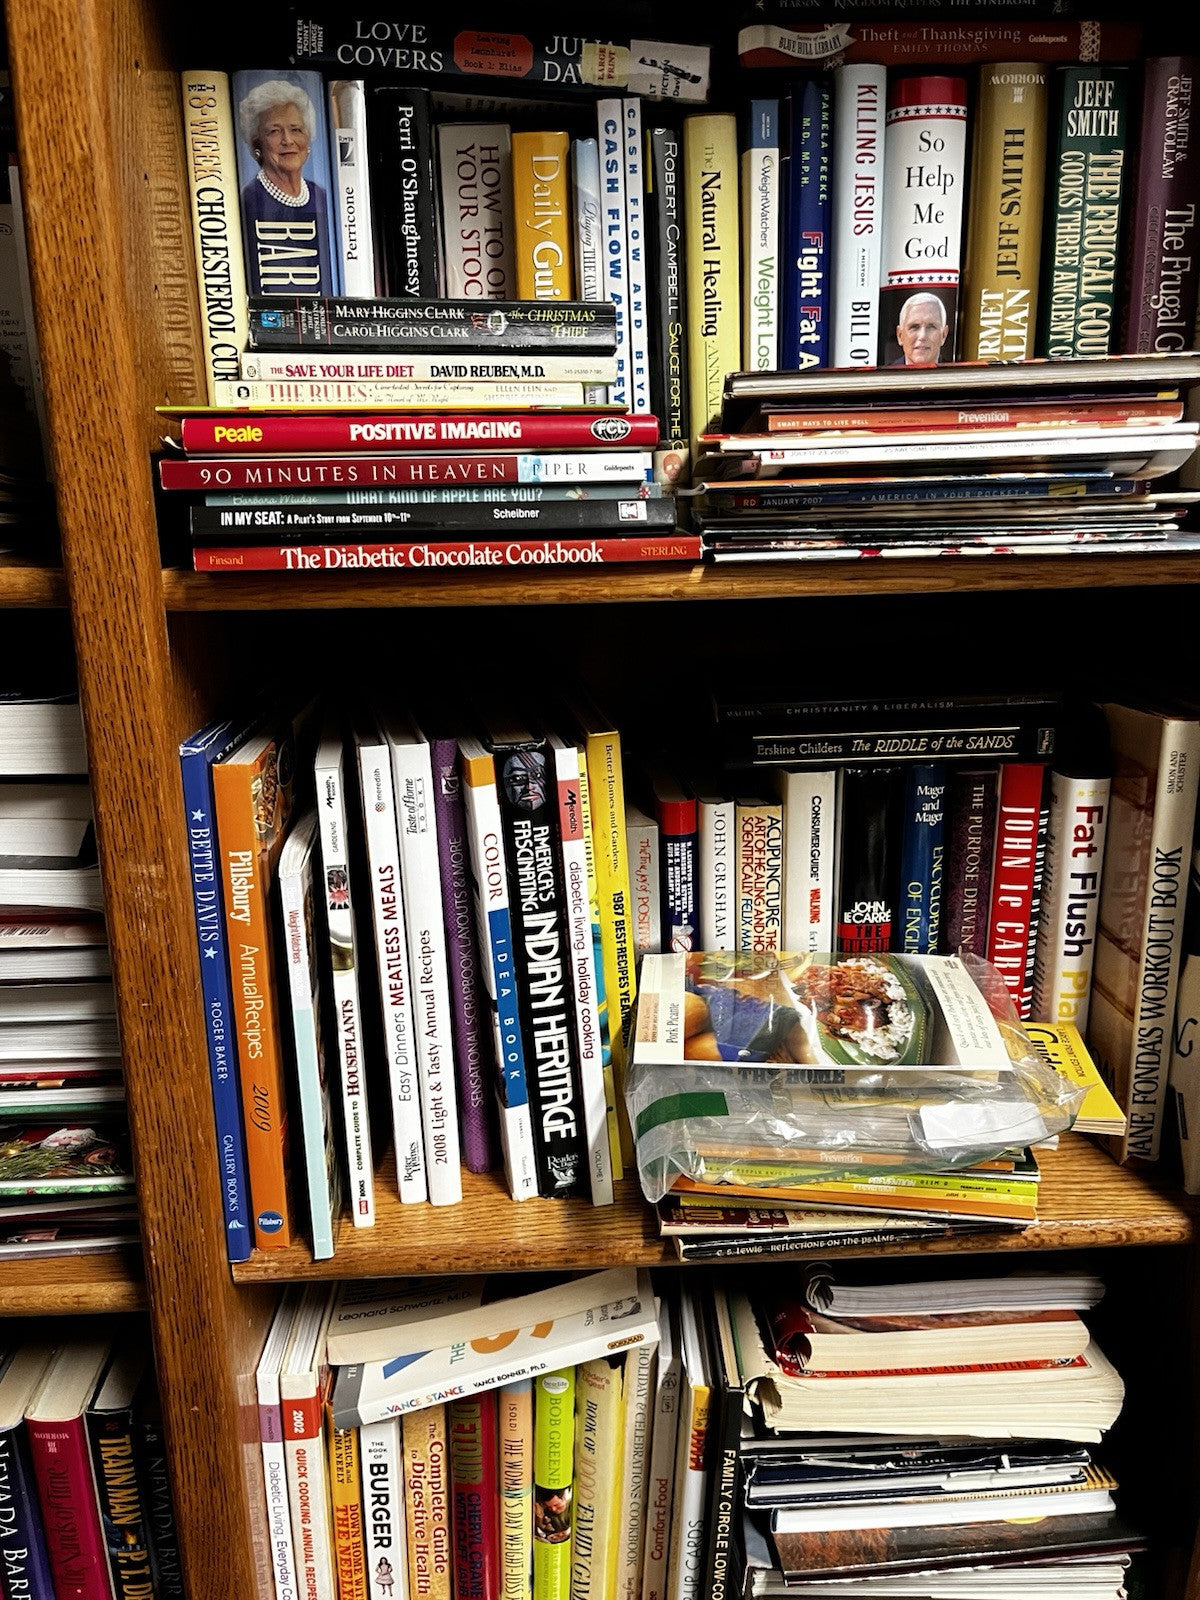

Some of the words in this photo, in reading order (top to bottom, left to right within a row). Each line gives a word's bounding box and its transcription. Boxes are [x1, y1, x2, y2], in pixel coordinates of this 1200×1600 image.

[355, 20, 428, 44] LOVE
[859, 28, 901, 42] Theft
[921, 28, 1021, 44] Thanksgiving
[1028, 34, 1068, 44] Guideposts
[892, 44, 932, 54] EMILY
[936, 43, 989, 53] THOMAS
[337, 44, 444, 72] COVERS
[989, 74, 1046, 84] MORROW
[1074, 80, 1115, 108] JEFF
[628, 108, 638, 174] CASH
[854, 84, 878, 164] KILLING
[918, 130, 945, 152] So
[1067, 110, 1120, 137] SMITH
[604, 119, 619, 193] CASH
[1000, 128, 1026, 217] SMITH
[1085, 150, 1124, 199] THE
[456, 143, 479, 221] YOUR
[906, 165, 954, 195] Help
[346, 186, 357, 261] Perricone
[853, 173, 875, 236] JESUS
[912, 203, 944, 224] Me
[1163, 204, 1195, 251] The
[607, 209, 622, 279] FLOW
[630, 198, 641, 261] FLOW
[905, 236, 948, 259] God
[996, 222, 1021, 280] JEFF
[1080, 204, 1119, 300] FRUGAL
[335, 305, 372, 319] MARY
[372, 305, 423, 319] HIGGINS
[425, 306, 465, 320] CLARK
[633, 283, 642, 329] AND
[1151, 255, 1192, 329] Frugal
[333, 324, 375, 338] CAROL
[376, 325, 428, 338] HIGGINS
[430, 326, 470, 338] CLARK
[850, 301, 870, 342] BILL
[285, 365, 317, 377] SAVE
[319, 365, 354, 377] YOUR
[358, 365, 383, 377] LIFE
[386, 365, 415, 377] DIET
[431, 366, 468, 377] DAVID
[470, 366, 519, 378] REUBEN,
[521, 365, 546, 377] M.D.
[215, 425, 263, 443] Peale
[349, 423, 436, 441] POSITIVE
[441, 422, 521, 439] IMAGING
[597, 421, 625, 435] FCL
[958, 411, 1009, 423] Prevention
[200, 469, 232, 484] 90
[246, 466, 358, 483] MINUTES
[373, 465, 396, 480] IN
[410, 462, 506, 480] HEAVEN
[532, 463, 588, 476] PIPER
[604, 464, 634, 472] Guideposts
[220, 512, 233, 526] IN
[234, 511, 252, 526] MY
[254, 511, 285, 525] SEAT:
[493, 508, 540, 519] Scheibner
[762, 498, 800, 506] JANUARY
[870, 494, 919, 502] AMERICA
[924, 492, 937, 501] IN
[209, 555, 244, 565] Finsand
[280, 547, 321, 570] The
[324, 546, 404, 569] Diabetic
[408, 544, 503, 568] Chocolate
[505, 541, 604, 565] Cookbook
[640, 546, 687, 556] STERLING
[757, 744, 796, 755] Erskine
[799, 742, 843, 755] Childers
[851, 739, 871, 752] The
[874, 738, 929, 753] RIDDLE
[931, 738, 944, 751] of
[946, 736, 964, 750] the
[965, 735, 1015, 750] SANDS
[917, 785, 945, 799] Mager
[922, 800, 939, 811] and
[972, 784, 985, 809] THE
[714, 811, 727, 857] JOHN
[915, 812, 943, 826] Mager
[1072, 805, 1104, 858] Fat
[190, 827, 215, 883] BETTE
[513, 820, 539, 912] FASCINATING
[532, 825, 555, 900] AMERICA'S
[741, 817, 753, 896] SCIENTIFICALLY
[964, 815, 983, 882] PURPOSE
[378, 864, 398, 921] MEALS
[714, 862, 727, 938] GRISHAM
[1151, 847, 1182, 909] BOOK
[197, 890, 219, 942] DAVIS
[742, 899, 752, 927] FELIX
[809, 888, 821, 924] WALKING
[851, 901, 885, 913] JOHN
[961, 888, 978, 945] DRIVEN
[1063, 871, 1097, 957] Flush
[383, 926, 405, 1006] MEATLESS
[523, 910, 567, 1010] INDIAN
[1138, 913, 1175, 1020] WORKOUT
[394, 1011, 408, 1066] Dinners
[399, 1072, 412, 1102] Easy
[532, 1014, 577, 1142] HERITAGE
[1132, 1027, 1164, 1105] FONDA'S
[222, 1134, 236, 1176] GALLERY
[1127, 1112, 1156, 1156] JANE
[226, 1177, 239, 1212] BOOKS
[257, 1217, 284, 1226] Pillsbury
[339, 1308, 388, 1321] Leonard
[390, 1299, 444, 1317] Schwartz,
[446, 1291, 472, 1303] M.D.
[387, 1397, 422, 1414] VANCE
[426, 1386, 465, 1404] STANCE
[473, 1374, 496, 1388] VANCE
[496, 1368, 529, 1385] BONNER,
[530, 1362, 548, 1375] Ph.D.
[608, 1334, 644, 1350] WORKMAN
[292, 1410, 305, 1433] 2002
[549, 1397, 561, 1427] BOB
[296, 1448, 307, 1478] QUICK
[411, 1449, 417, 1459] to
[548, 1431, 560, 1485] GREENE
[721, 1450, 736, 1498] FAMILY
[99, 1435, 142, 1525] TRAINMAN
[269, 1462, 280, 1504] Diabetic
[298, 1481, 311, 1525] COOKING
[409, 1461, 429, 1539] Digestive
[427, 1441, 446, 1522] Complete
[272, 1502, 284, 1535] Living
[369, 1463, 392, 1549] BURGER
[716, 1501, 732, 1548] CIRCLE
[277, 1540, 290, 1586] Everyday
[301, 1527, 314, 1564] ANNUAL
[415, 1543, 431, 1594] Health
[433, 1526, 448, 1574] Guide
